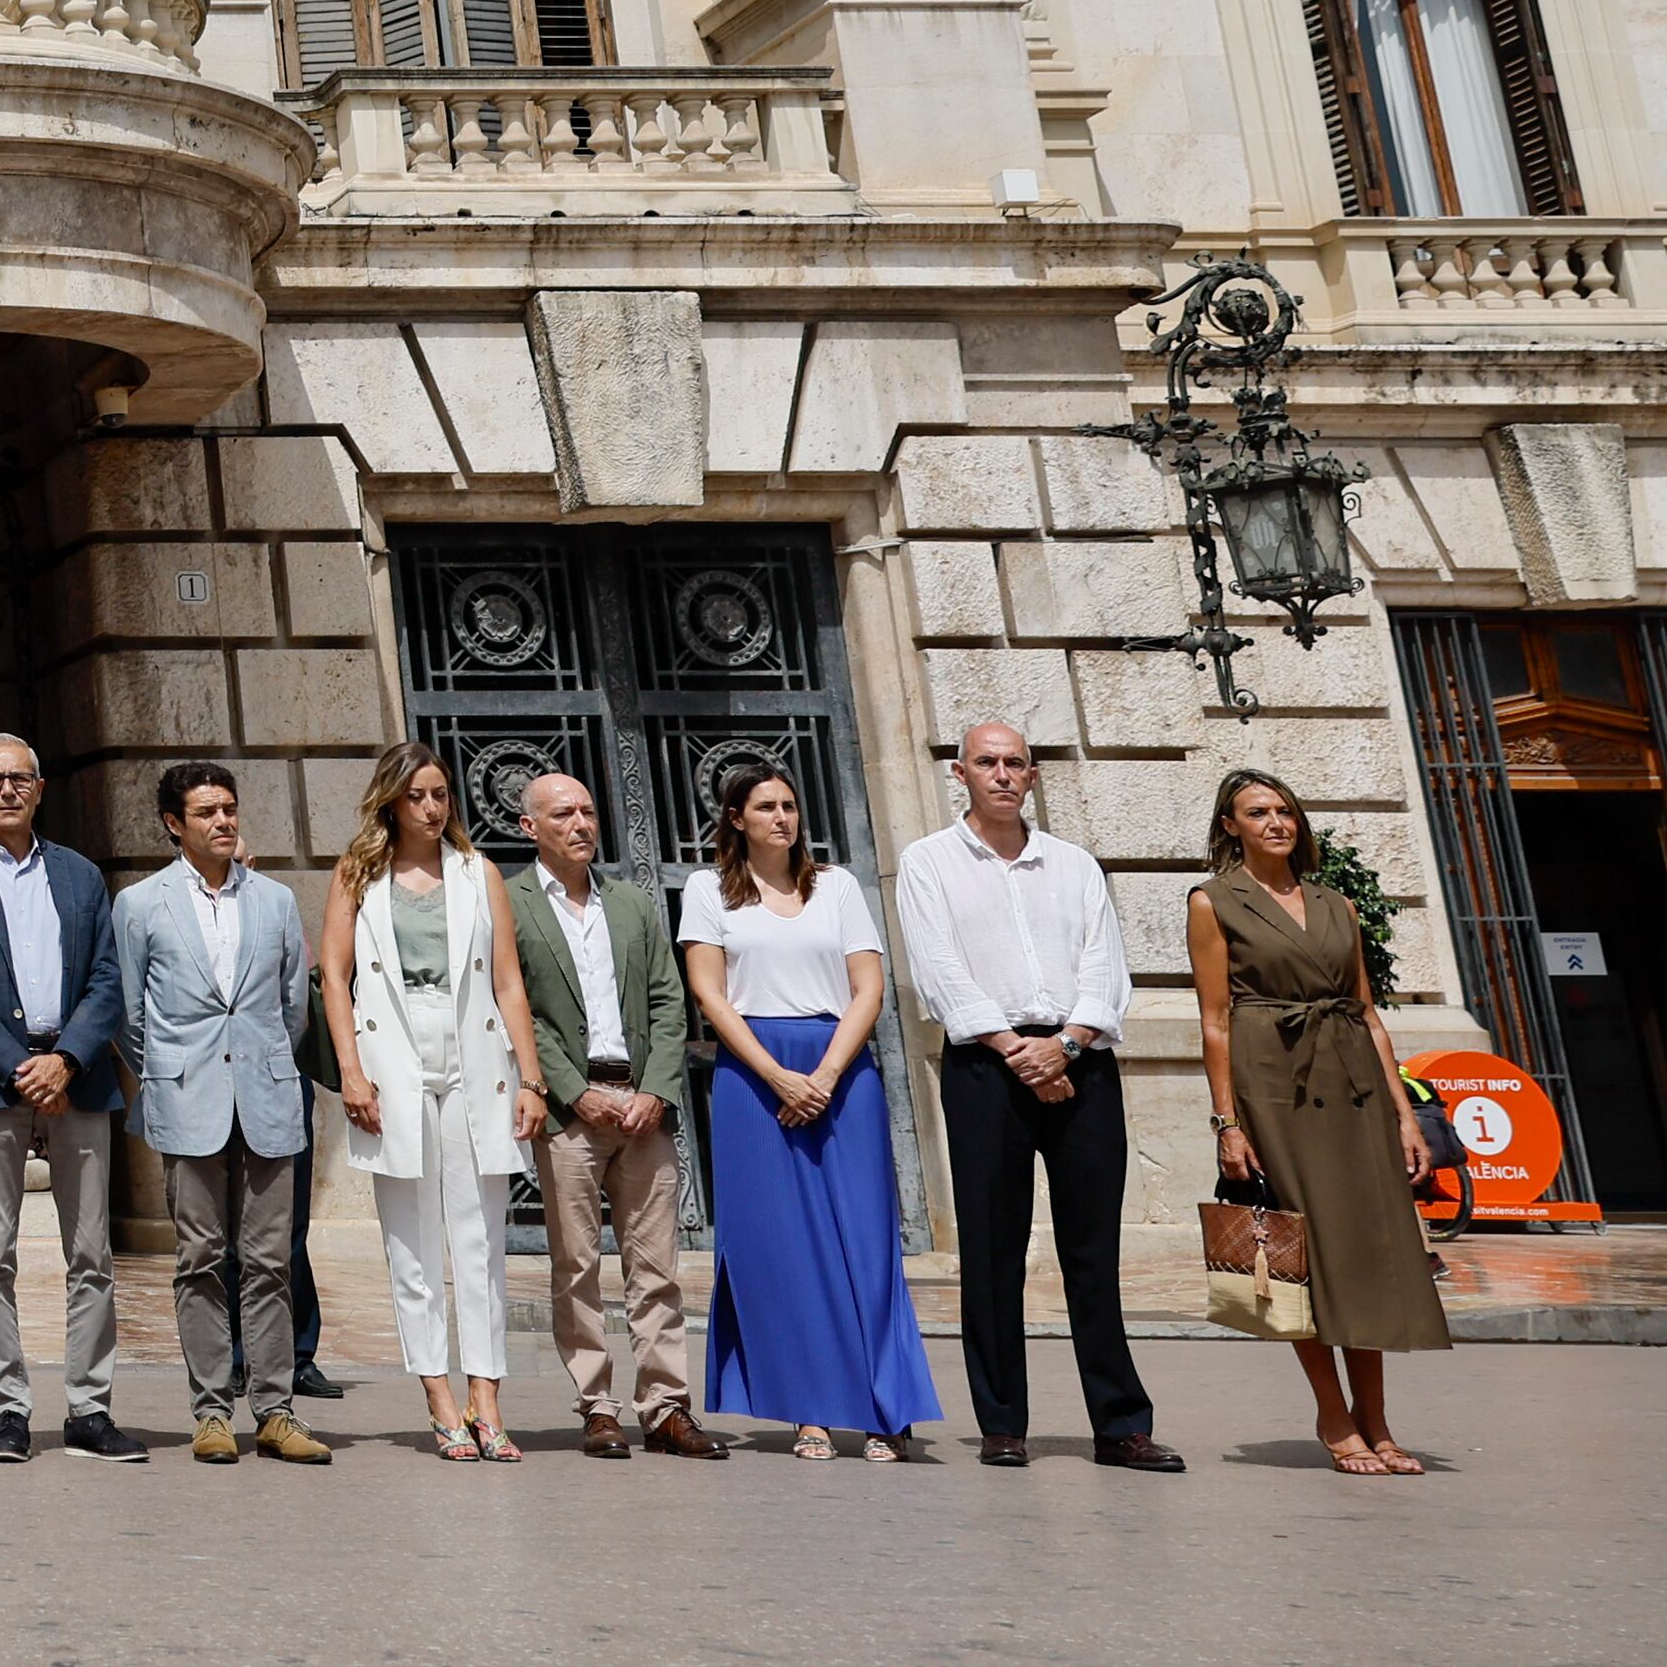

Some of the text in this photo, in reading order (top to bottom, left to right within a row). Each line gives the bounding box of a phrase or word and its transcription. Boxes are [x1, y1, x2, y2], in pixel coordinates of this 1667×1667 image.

[188, 577, 196, 598] 1
[1428, 1078, 1521, 1092] TOURIST INFO
[1471, 1206, 1549, 1216] sitvalencia.com
